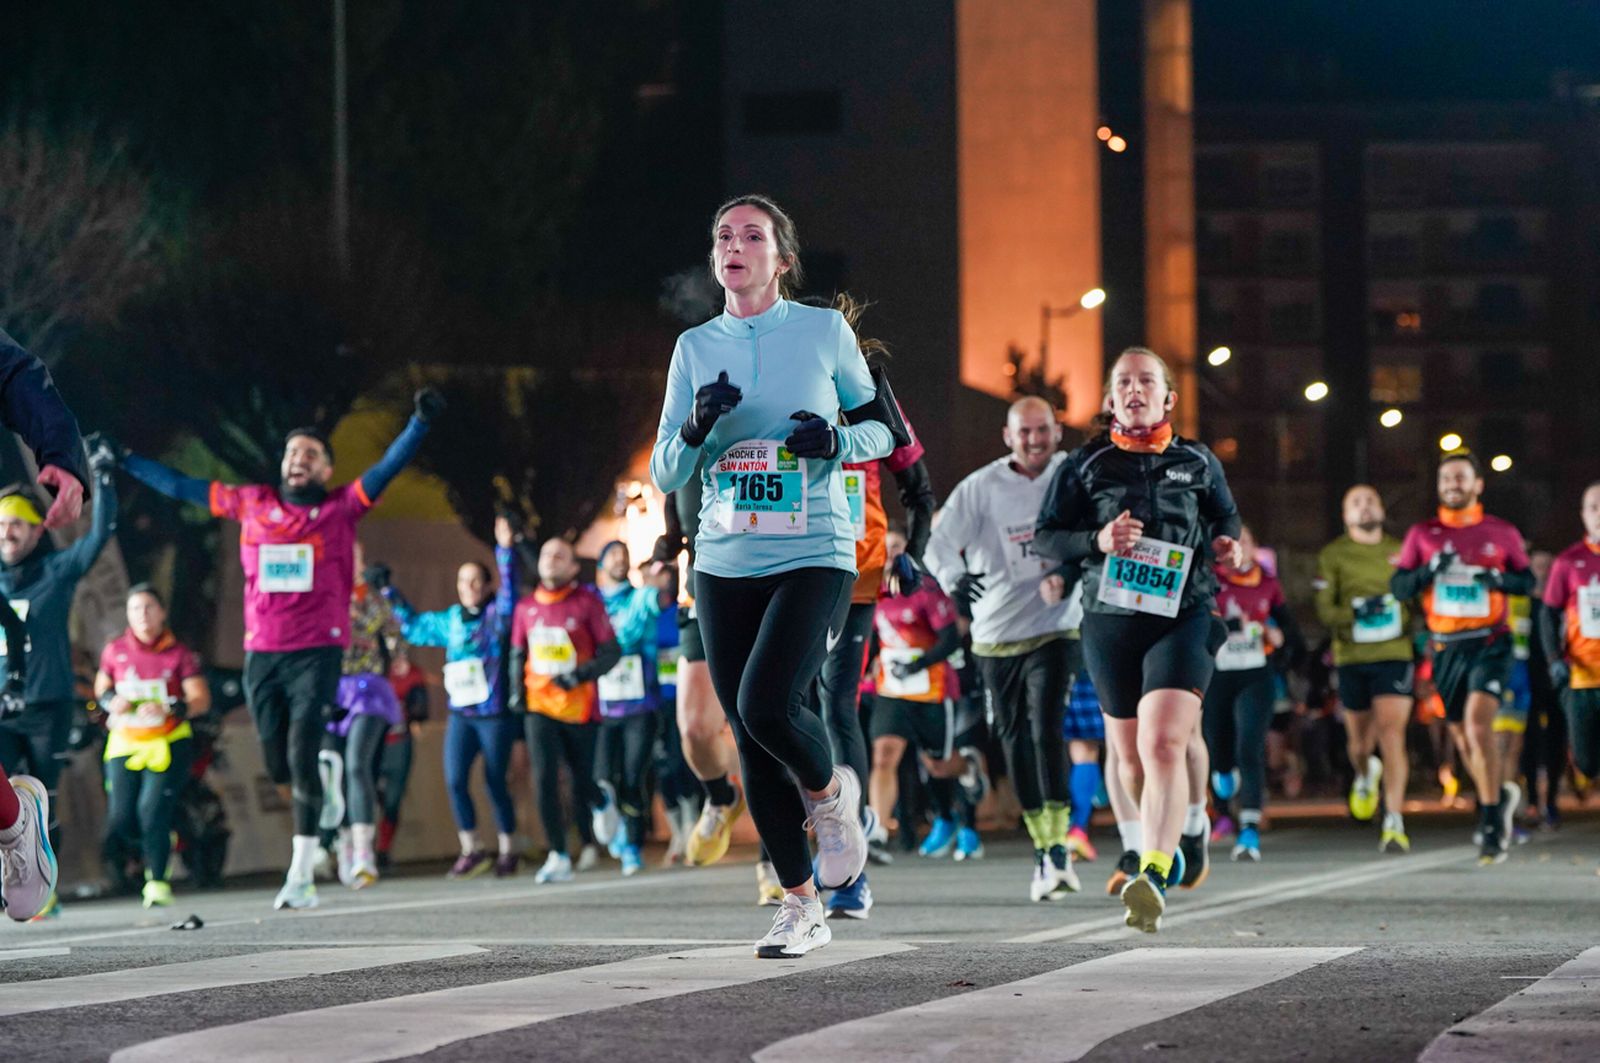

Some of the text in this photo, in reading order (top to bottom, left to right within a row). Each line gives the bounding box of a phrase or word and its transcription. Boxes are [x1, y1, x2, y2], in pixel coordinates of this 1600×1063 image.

[728, 449, 755, 459] NOCHE
[757, 449, 768, 459] DE
[729, 473, 784, 502] 1165
[1115, 559, 1177, 591] 13854
